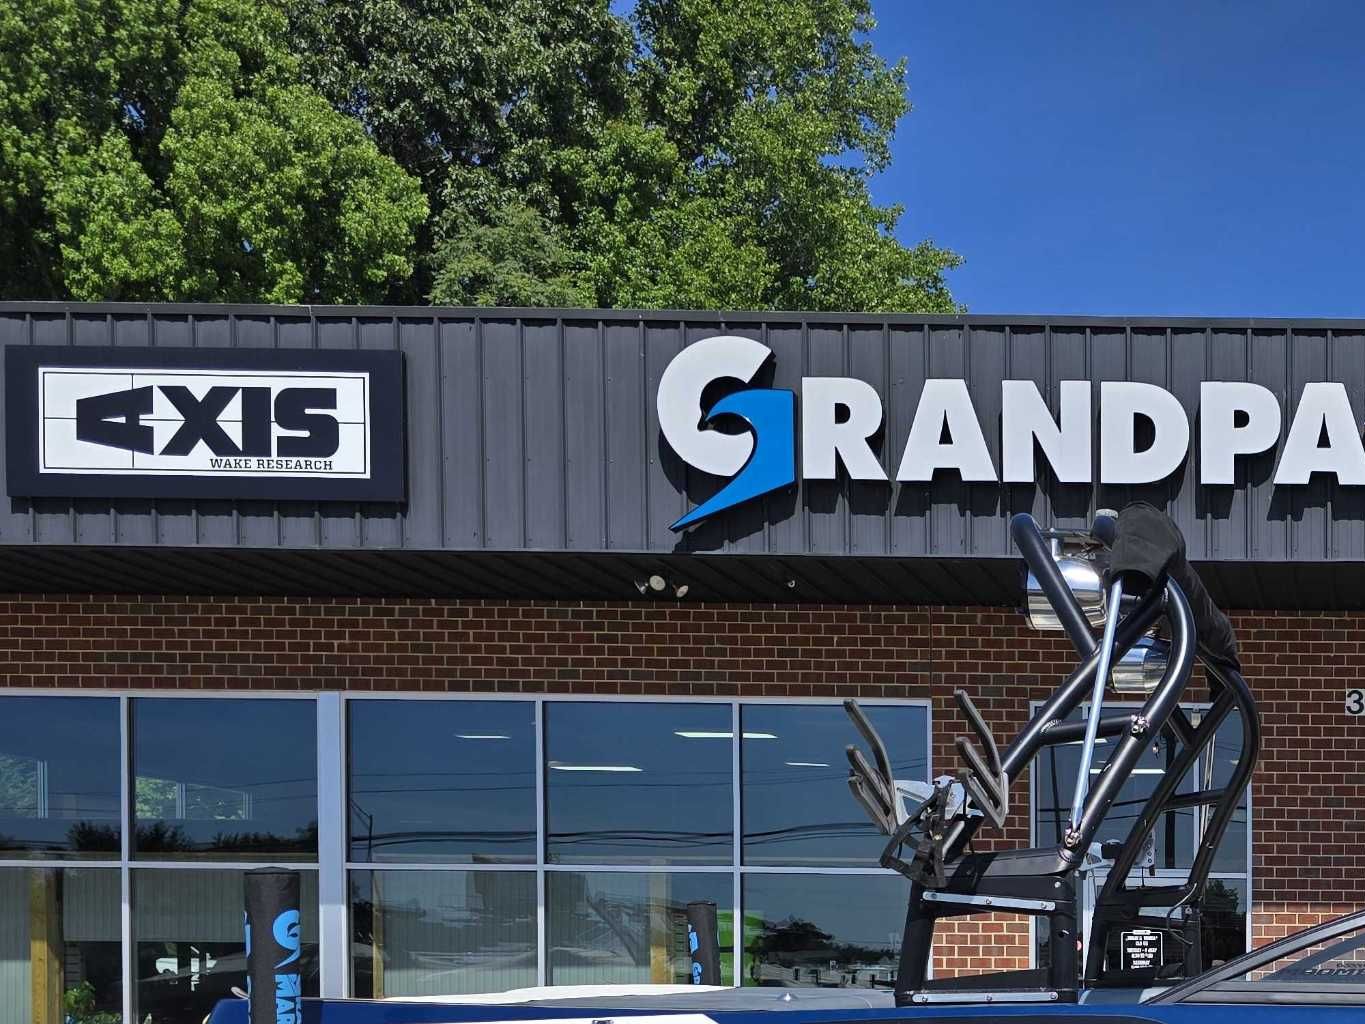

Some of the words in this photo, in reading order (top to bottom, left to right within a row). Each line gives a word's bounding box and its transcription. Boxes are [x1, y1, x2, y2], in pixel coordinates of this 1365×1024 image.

[76, 385, 340, 458] AXIS
[210, 458, 252, 469] WAKE
[257, 458, 333, 471] RESEARCH
